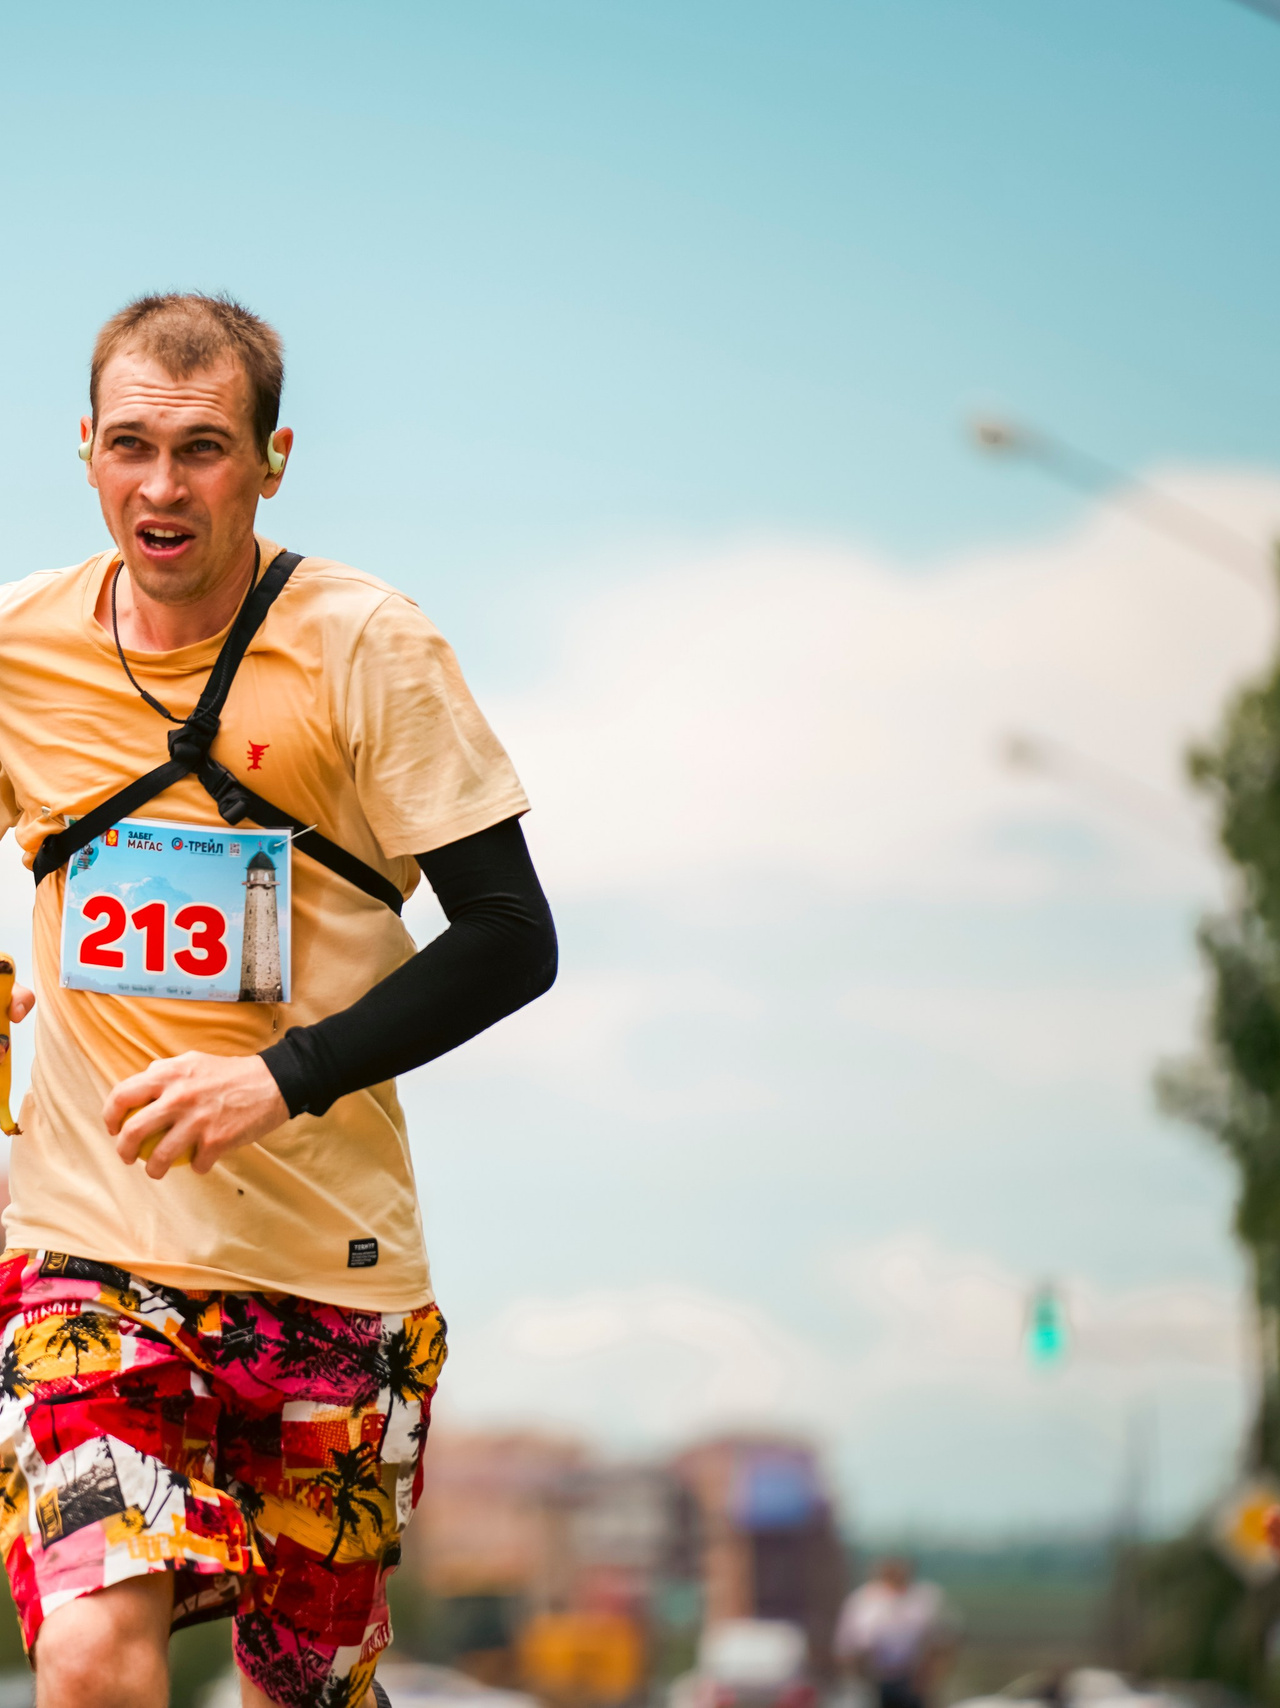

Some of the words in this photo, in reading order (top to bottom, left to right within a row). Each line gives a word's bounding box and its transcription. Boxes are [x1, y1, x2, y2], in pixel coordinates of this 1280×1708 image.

[128, 831, 153, 840] ЗАБЕГ
[127, 839, 163, 851] МАГАС
[79, 895, 228, 976] 213
